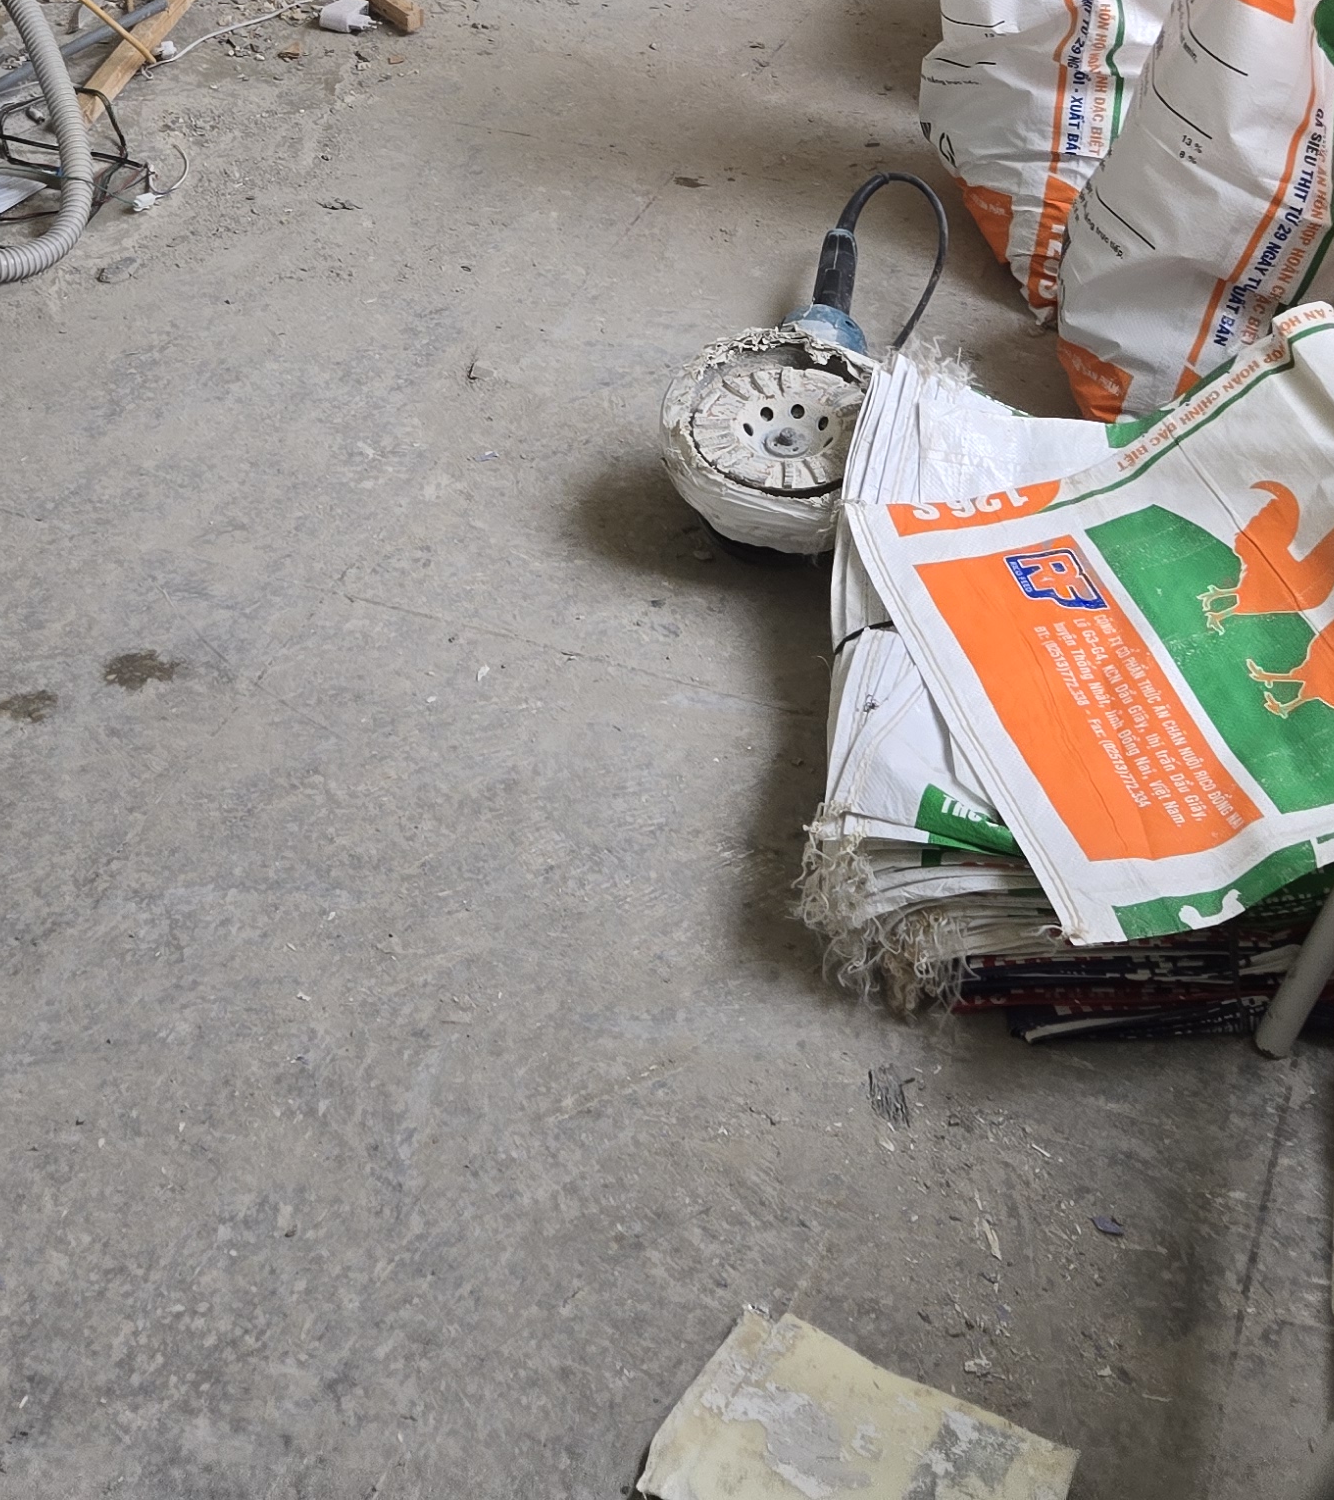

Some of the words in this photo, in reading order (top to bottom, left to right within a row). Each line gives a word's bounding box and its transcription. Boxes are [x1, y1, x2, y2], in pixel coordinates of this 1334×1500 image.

[1071, 37, 1085, 54] 29
[1068, 96, 1084, 127] XUẤT
[1180, 135, 1193, 146] 13
[1192, 143, 1204, 154] %
[1301, 132, 1324, 166] SIÊU
[1186, 155, 1198, 164] %
[1294, 171, 1314, 202] THỊT
[1283, 204, 1303, 226] TỪ
[1273, 222, 1293, 242] 29
[1255, 242, 1281, 276] NGÀY
[1224, 286, 1247, 315] UẤT
[1211, 315, 1235, 347] BÁN
[1219, 360, 1260, 392] HOÀN
[1180, 390, 1222, 425] CHỈNH
[1117, 445, 1148, 471] BIỆT
[1101, 662, 1122, 685] KCN
[1087, 714, 1108, 740] Fax:
[1132, 754, 1156, 779] Nai,
[1149, 776, 1173, 802] Việt
[1163, 798, 1188, 829] Nam.
[1193, 767, 1213, 793] RICO
